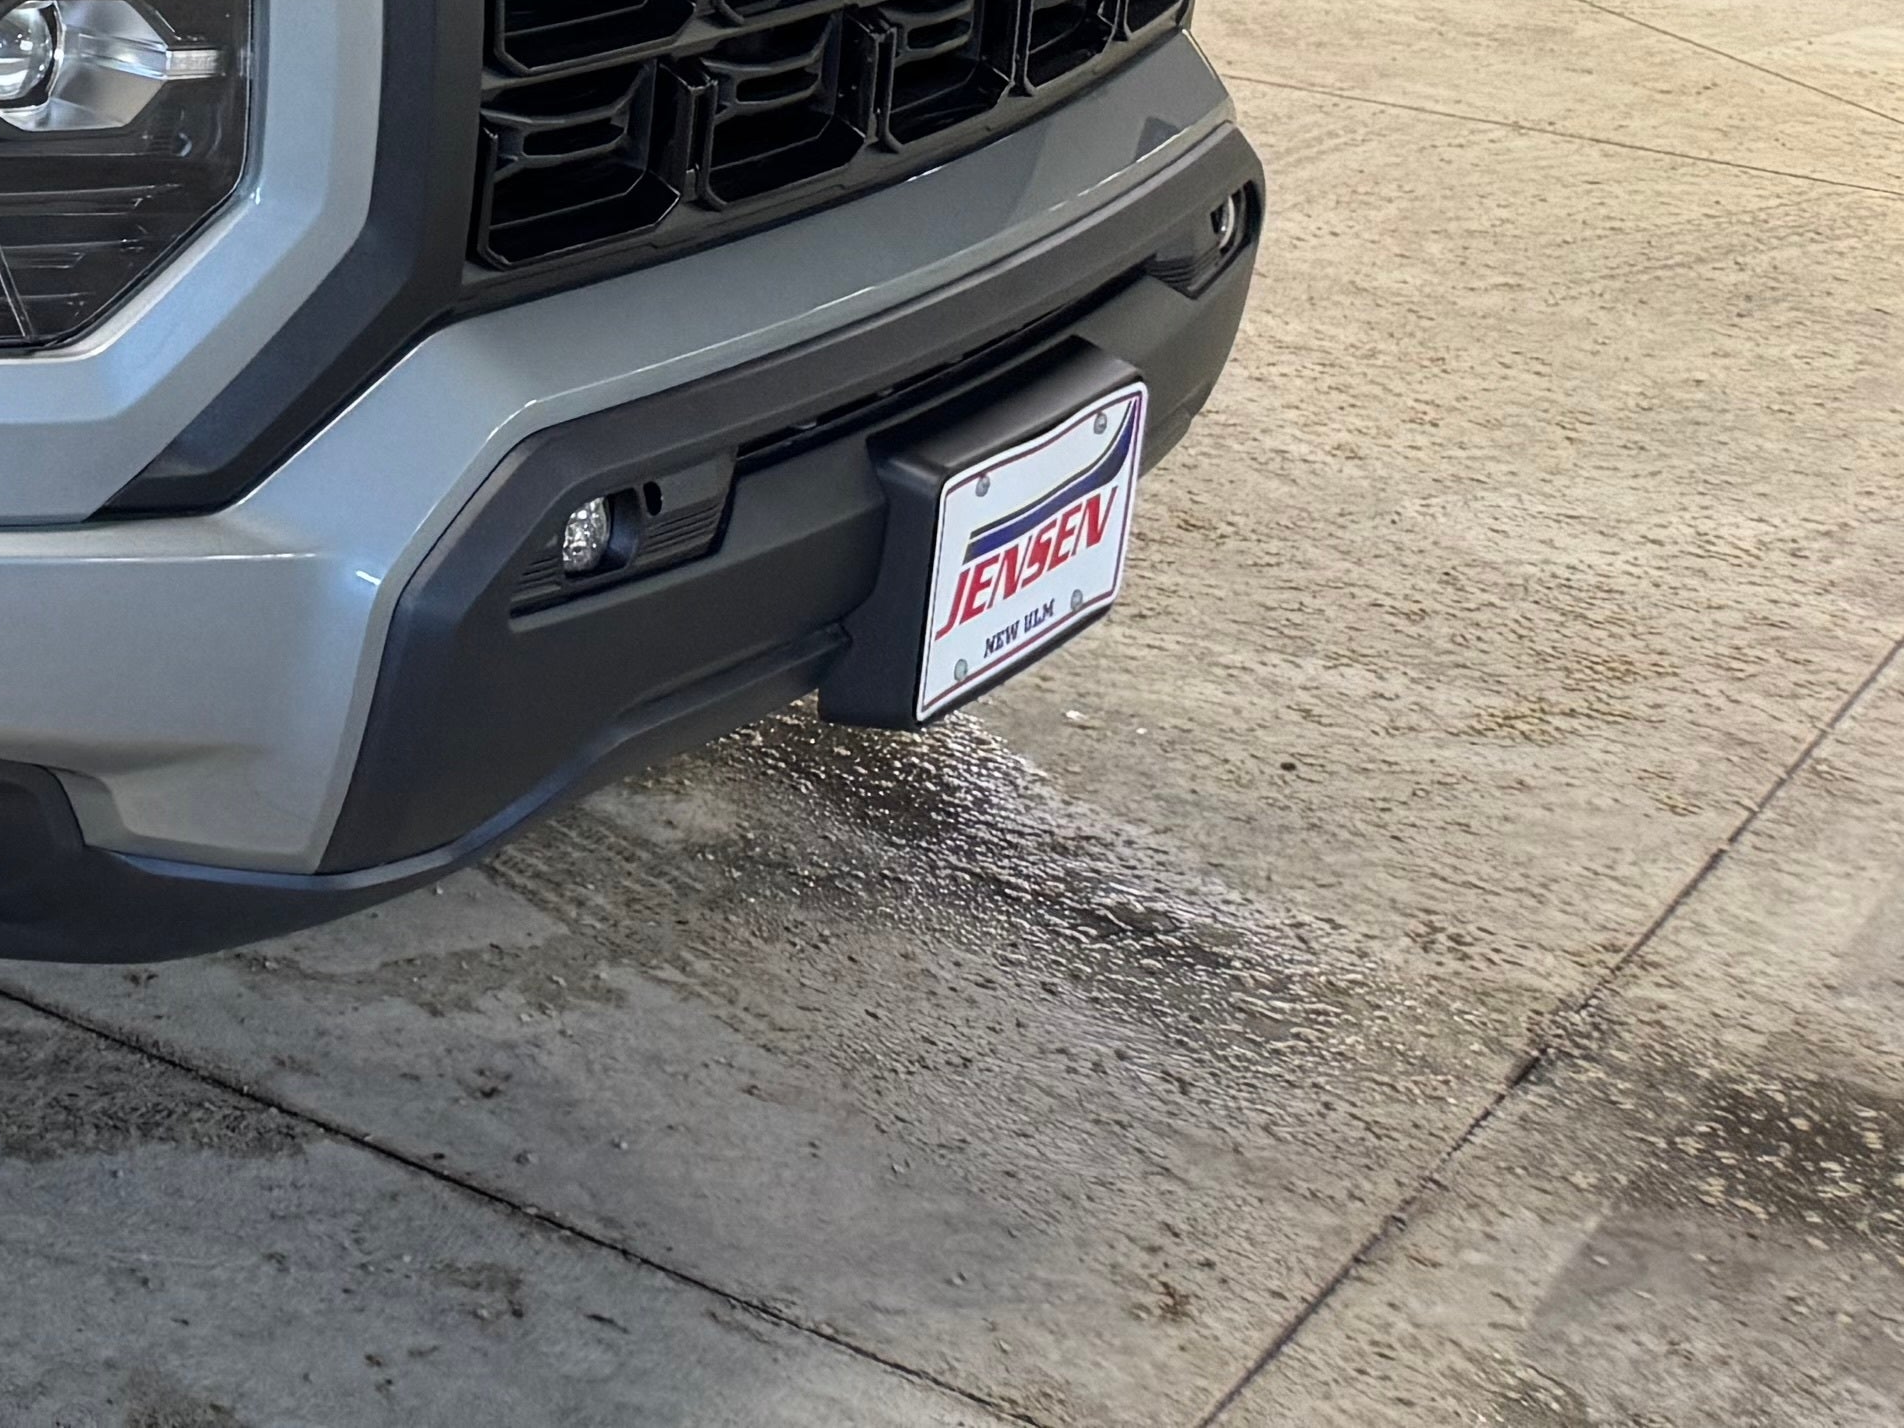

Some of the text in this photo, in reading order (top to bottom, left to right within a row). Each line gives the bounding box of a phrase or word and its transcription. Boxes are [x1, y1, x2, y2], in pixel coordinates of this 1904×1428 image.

[934, 485, 1119, 642] JENSEN
[983, 597, 1056, 659] NEW ULM
